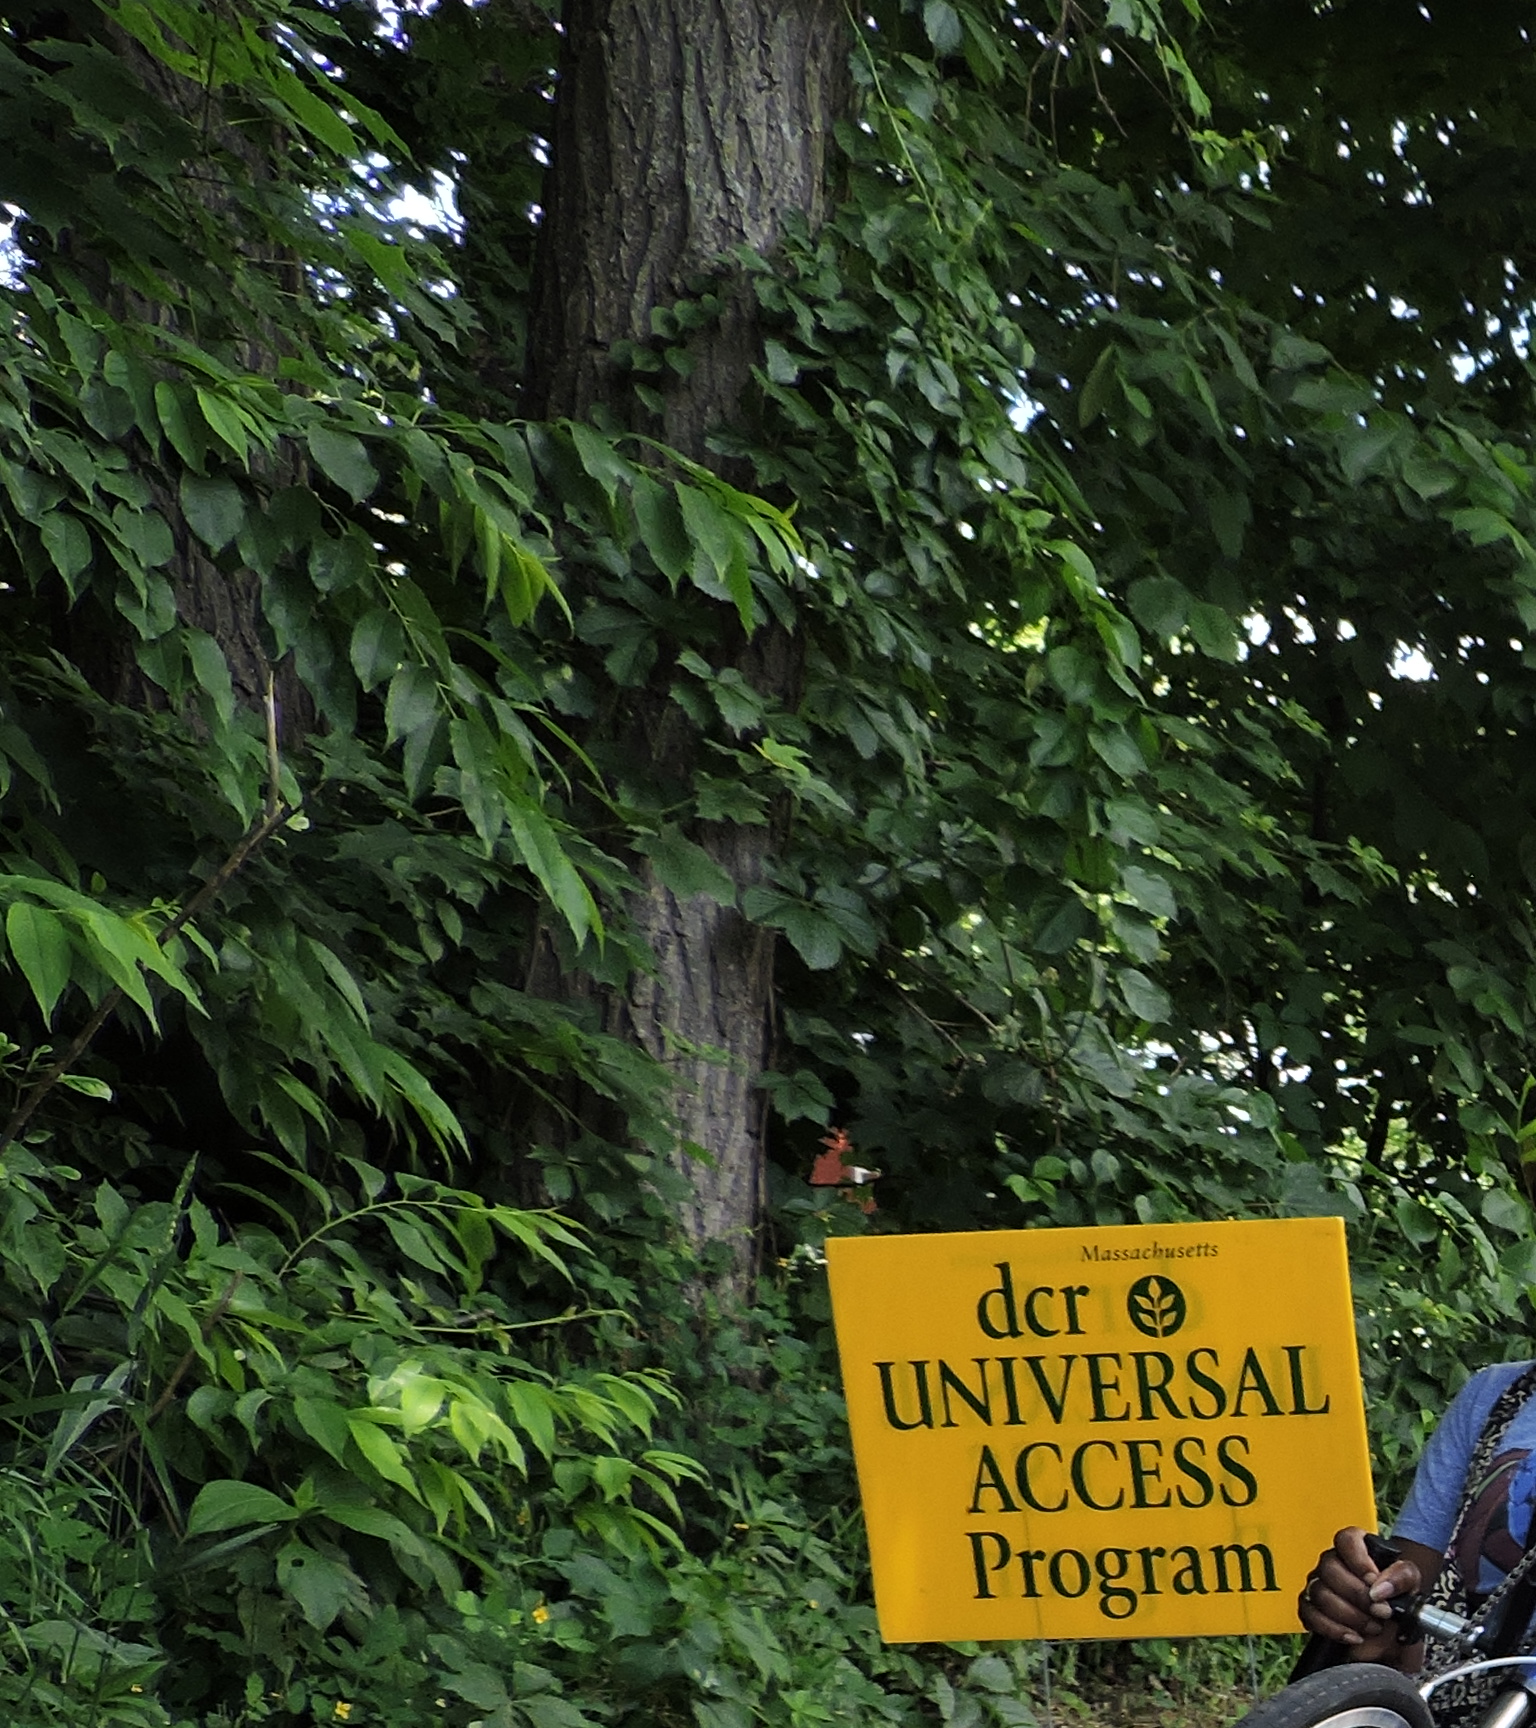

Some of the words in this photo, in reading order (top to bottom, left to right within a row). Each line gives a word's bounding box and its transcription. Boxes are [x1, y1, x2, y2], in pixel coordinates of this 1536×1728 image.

[1081, 1241, 1219, 1262] Massachusetts
[976, 1261, 1091, 1340] dcr
[872, 1345, 1331, 1431] UNIVERSAL
[966, 1435, 1259, 1514] ACCESS
[964, 1530, 1283, 1620] Program
